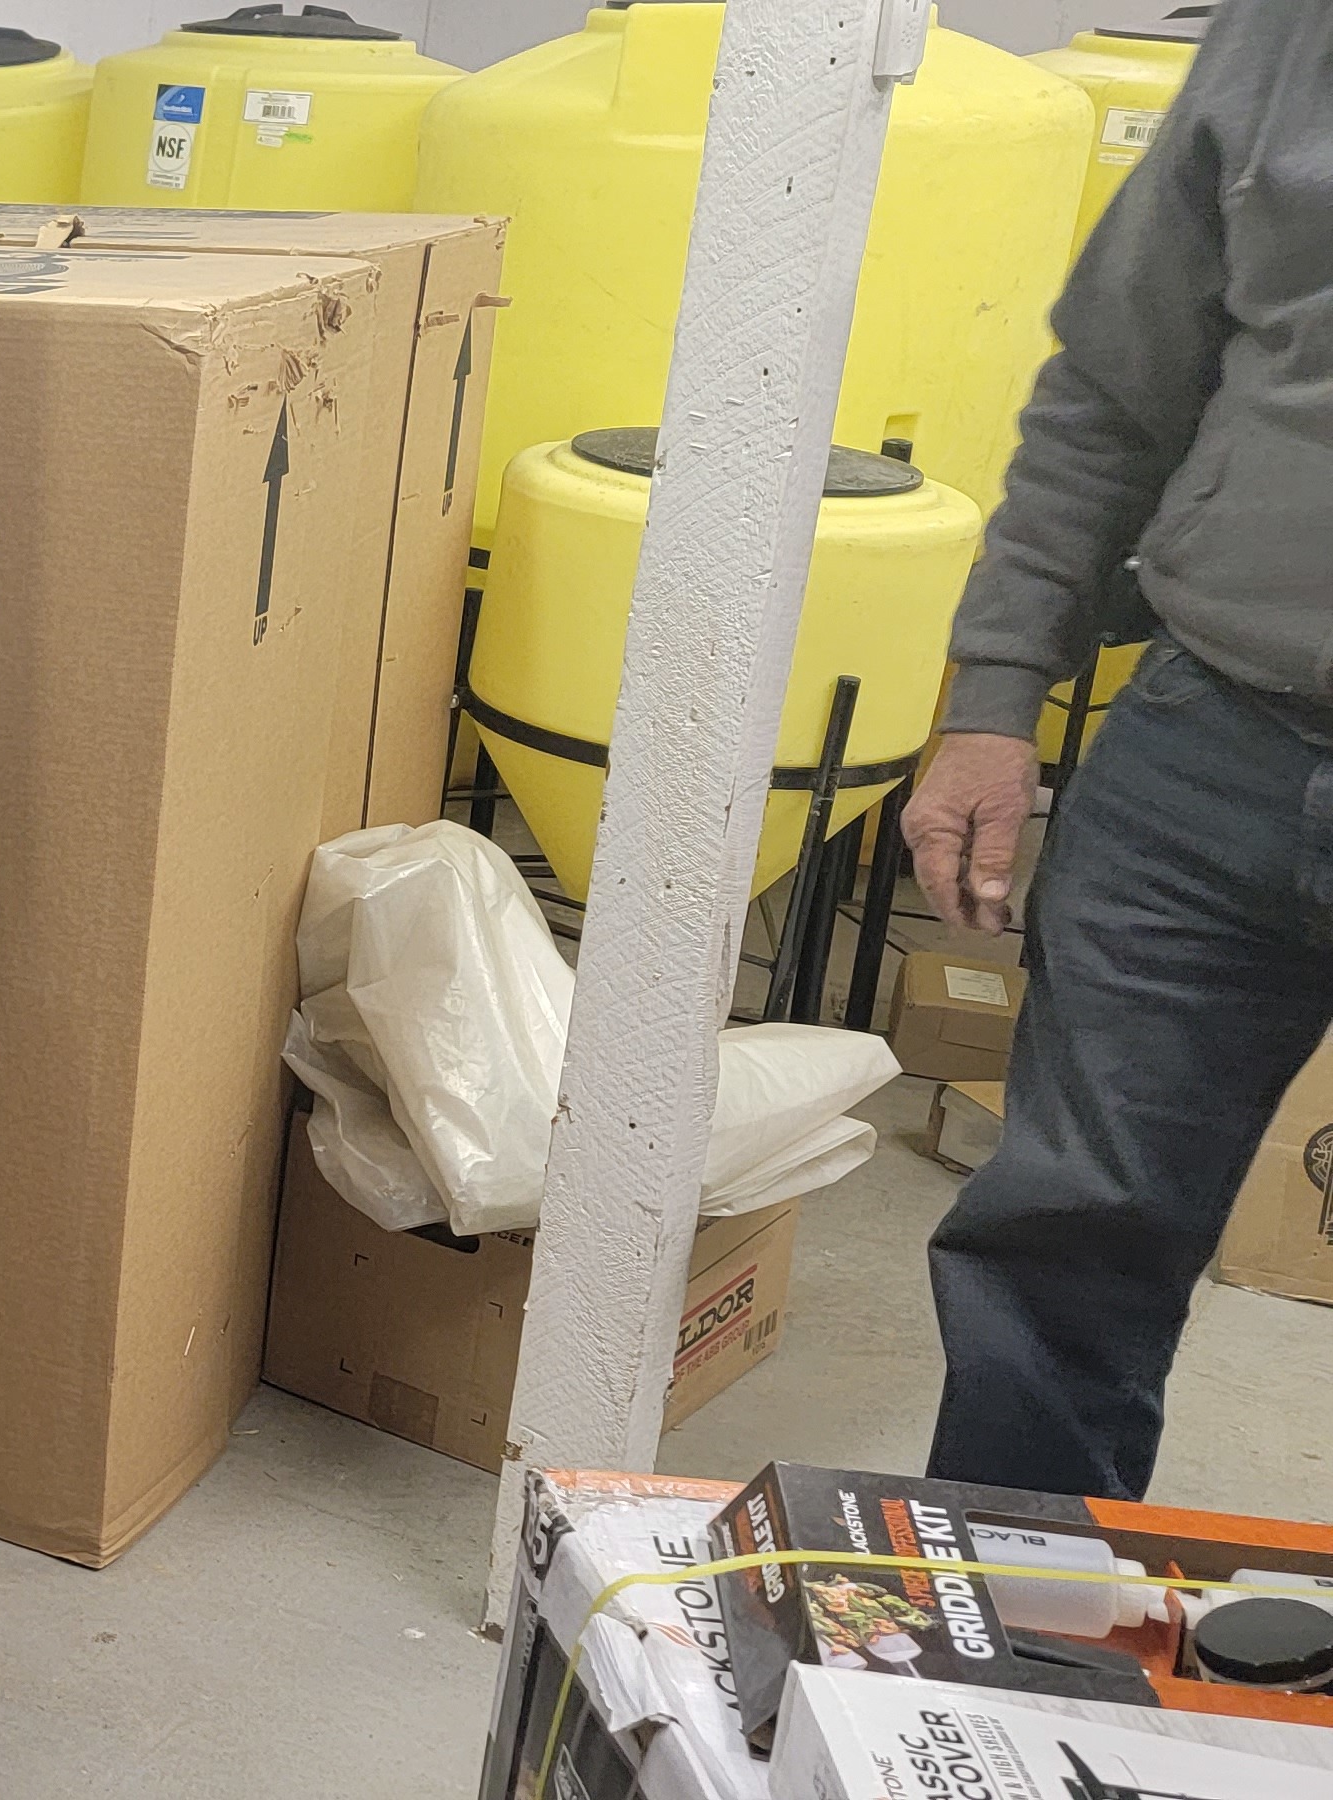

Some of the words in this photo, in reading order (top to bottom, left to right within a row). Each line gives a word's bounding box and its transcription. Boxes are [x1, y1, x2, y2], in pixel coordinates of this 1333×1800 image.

[155, 134, 187, 160] NSF
[746, 1492, 769, 1527] KIT
[837, 1488, 871, 1556] LACKSTONE
[909, 1499, 957, 1542] KIT
[967, 1712, 1004, 1752] SHELVES
[919, 1708, 994, 1800] COVER
[988, 1754, 1017, 1779] HIGH
